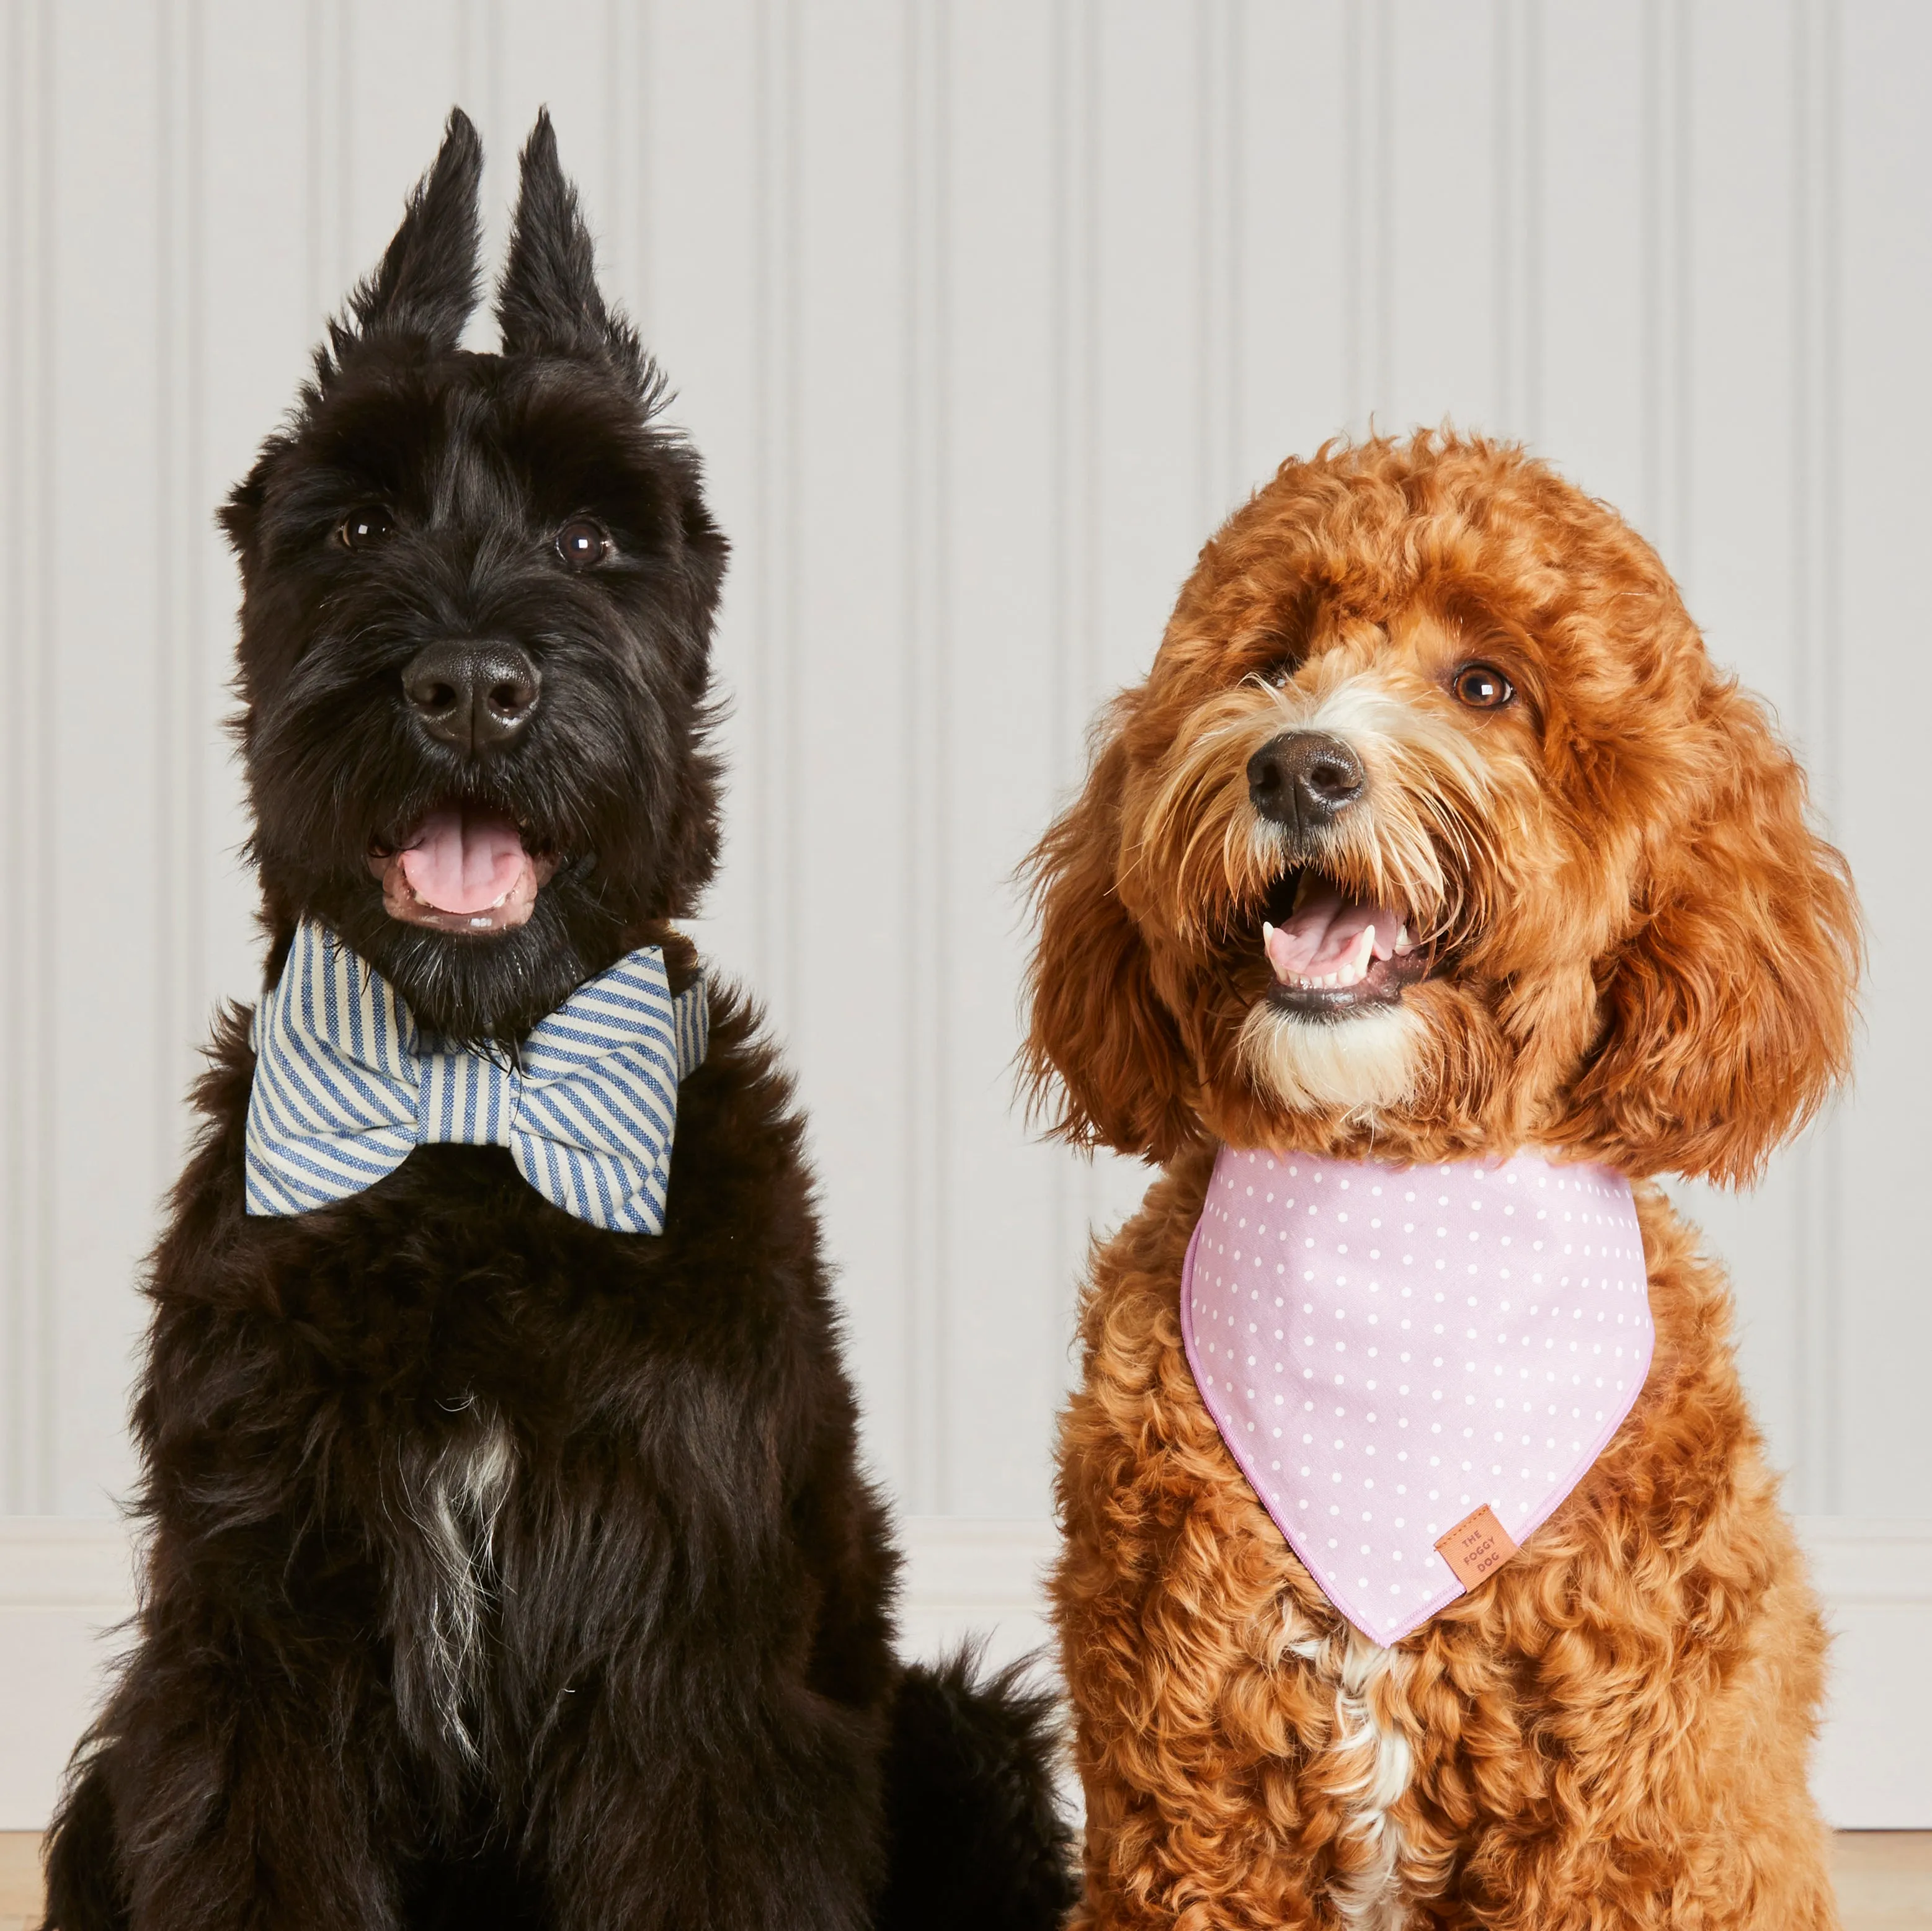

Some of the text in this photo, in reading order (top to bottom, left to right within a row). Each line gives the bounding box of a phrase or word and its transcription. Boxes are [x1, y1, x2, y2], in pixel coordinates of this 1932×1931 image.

[1462, 1530, 1482, 1548] THE
[1463, 1537, 1495, 1565] FOGGY
[1477, 1552, 1500, 1572] DOG
